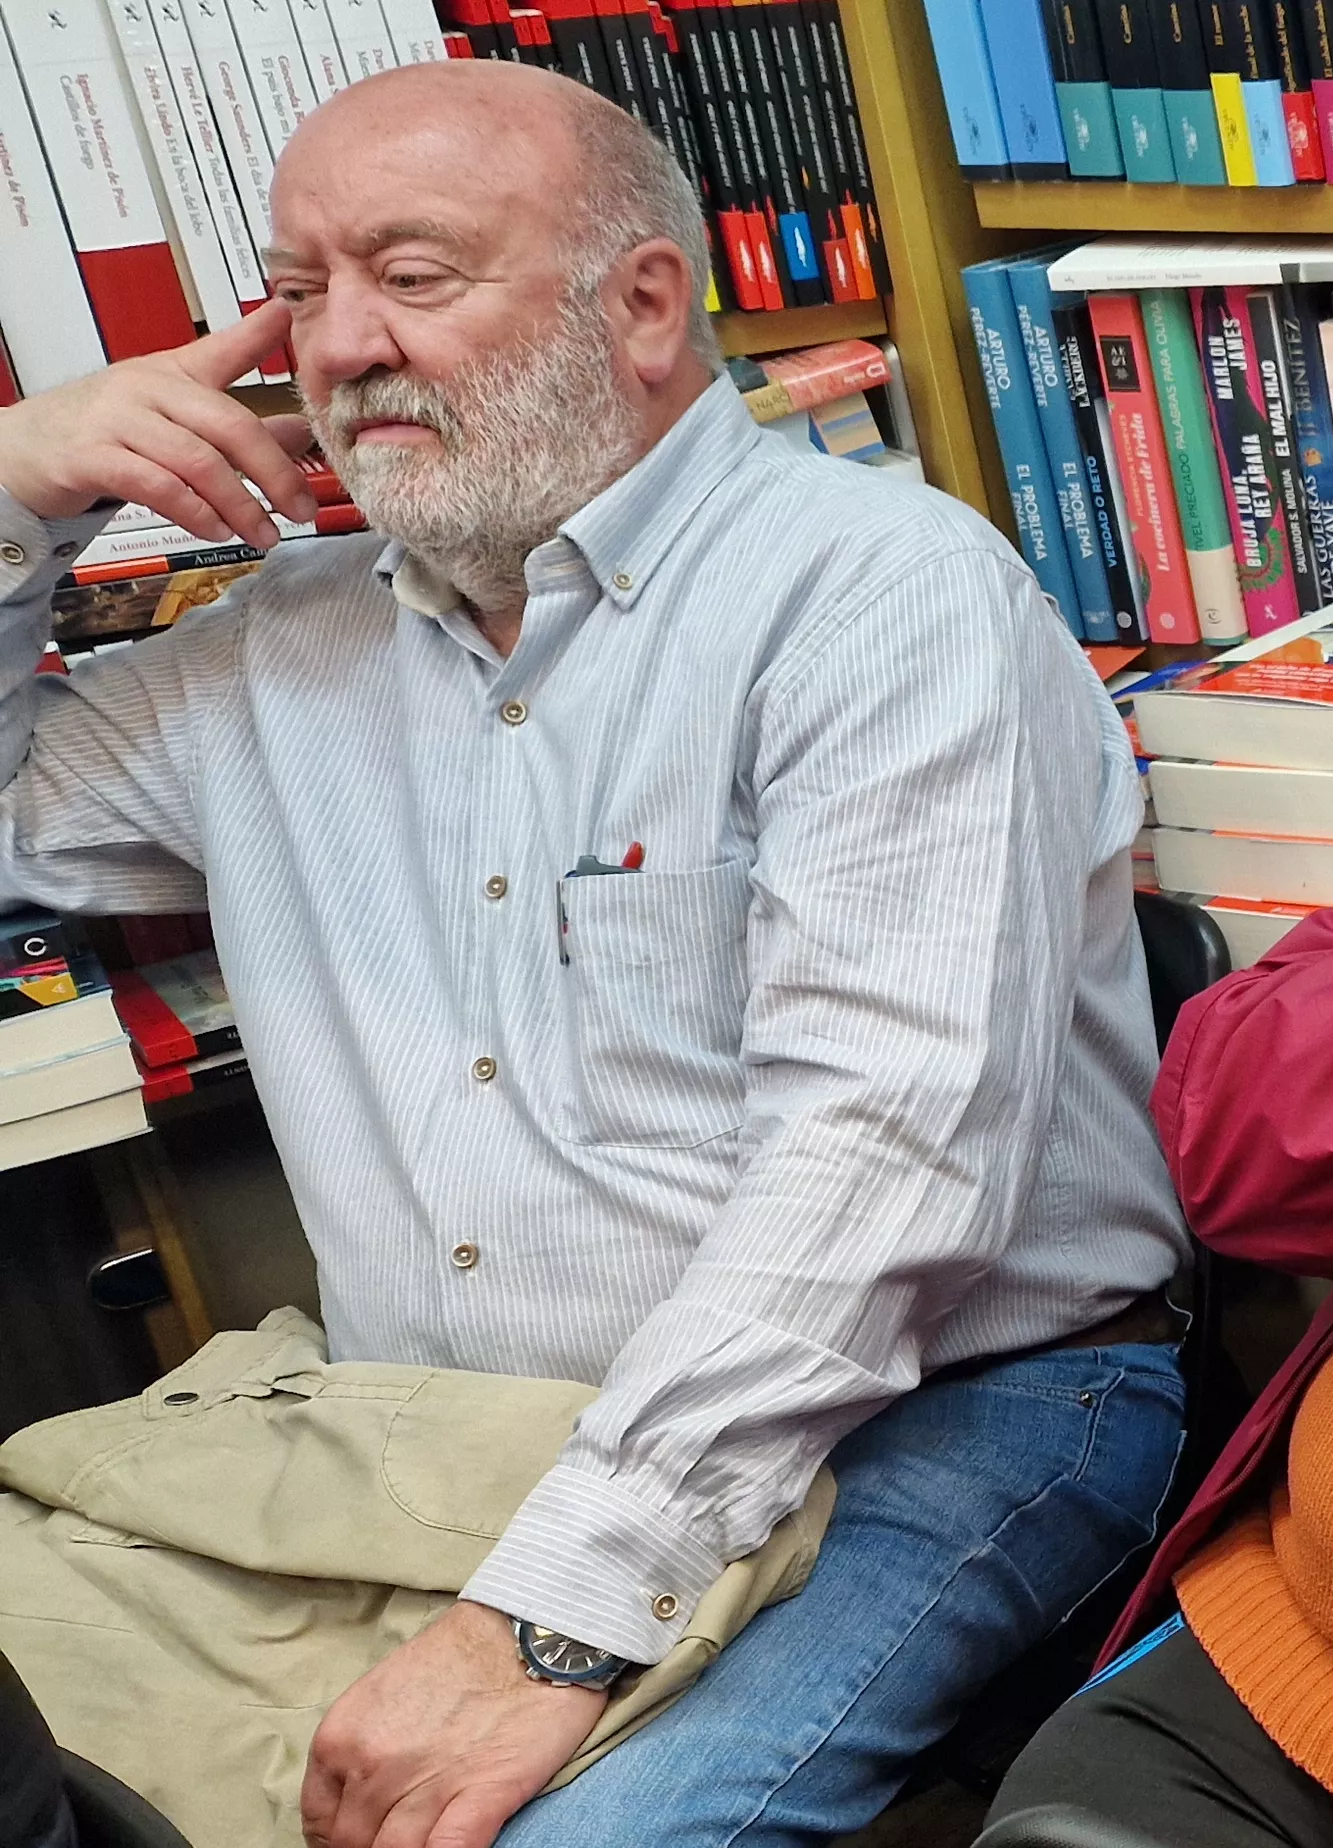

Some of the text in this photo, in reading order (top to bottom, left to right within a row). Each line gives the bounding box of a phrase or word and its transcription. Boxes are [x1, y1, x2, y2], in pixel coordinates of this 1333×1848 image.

[76, 73, 128, 218] Ignacio Martínez de Pisón
[970, 306, 1000, 409] PÉREZ-REVERTE
[986, 328, 1010, 390] ARTURO
[1017, 305, 1047, 407] PÉREZ-REVERTE
[1033, 326, 1058, 387] ARTURO
[1208, 317, 1248, 400] MARLON JAMES
[1150, 302, 1200, 514] PRECIADO PALABRAS PARA OLIVIA
[1261, 359, 1290, 457] EL MAL HIJO
[1011, 492, 1027, 531] FINAL
[1016, 464, 1047, 560] EL PROBLEMA
[1056, 490, 1073, 528] FINAL
[1062, 462, 1093, 559] EL PROBLEMA
[1086, 456, 1119, 568] VERDAD O RETO
[1130, 413, 1171, 571] La cocinera de Frida
[1233, 471, 1262, 568] BRUJA LUNA,
[1242, 434, 1272, 518] REY ARAÑA
[1305, 474, 1331, 566] GUERRAS
[110, 537, 158, 553] Antonio
[193, 552, 237, 565] Andrea
